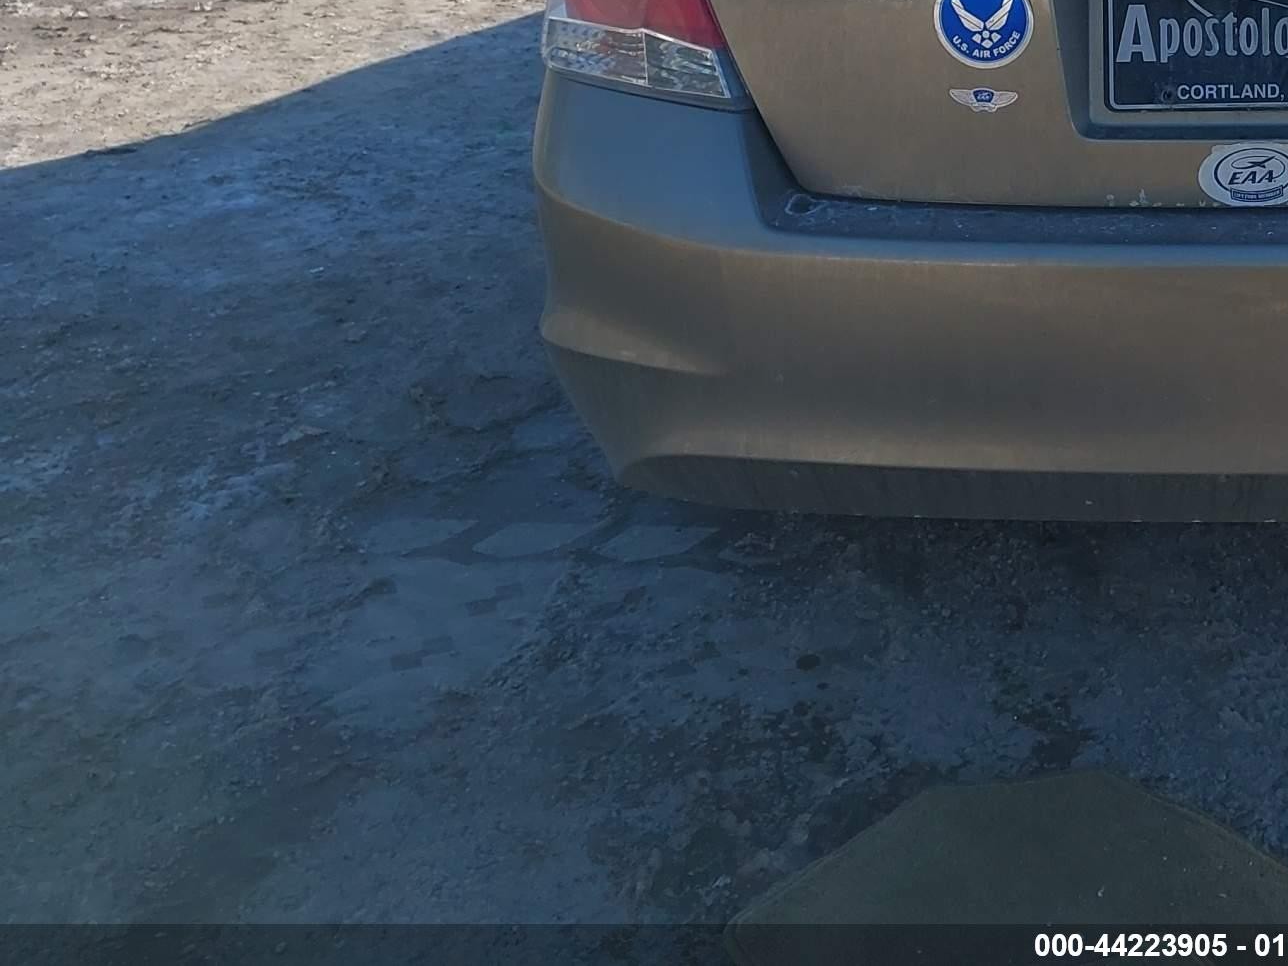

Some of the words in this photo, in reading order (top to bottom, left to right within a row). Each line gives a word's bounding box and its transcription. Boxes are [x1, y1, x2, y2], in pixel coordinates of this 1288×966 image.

[952, 35, 970, 54] U.S.
[972, 49, 991, 59] AIR
[993, 31, 1021, 58] FORCE
[1177, 84, 1285, 101] CORTLAND,
[1228, 170, 1277, 185] EAA
